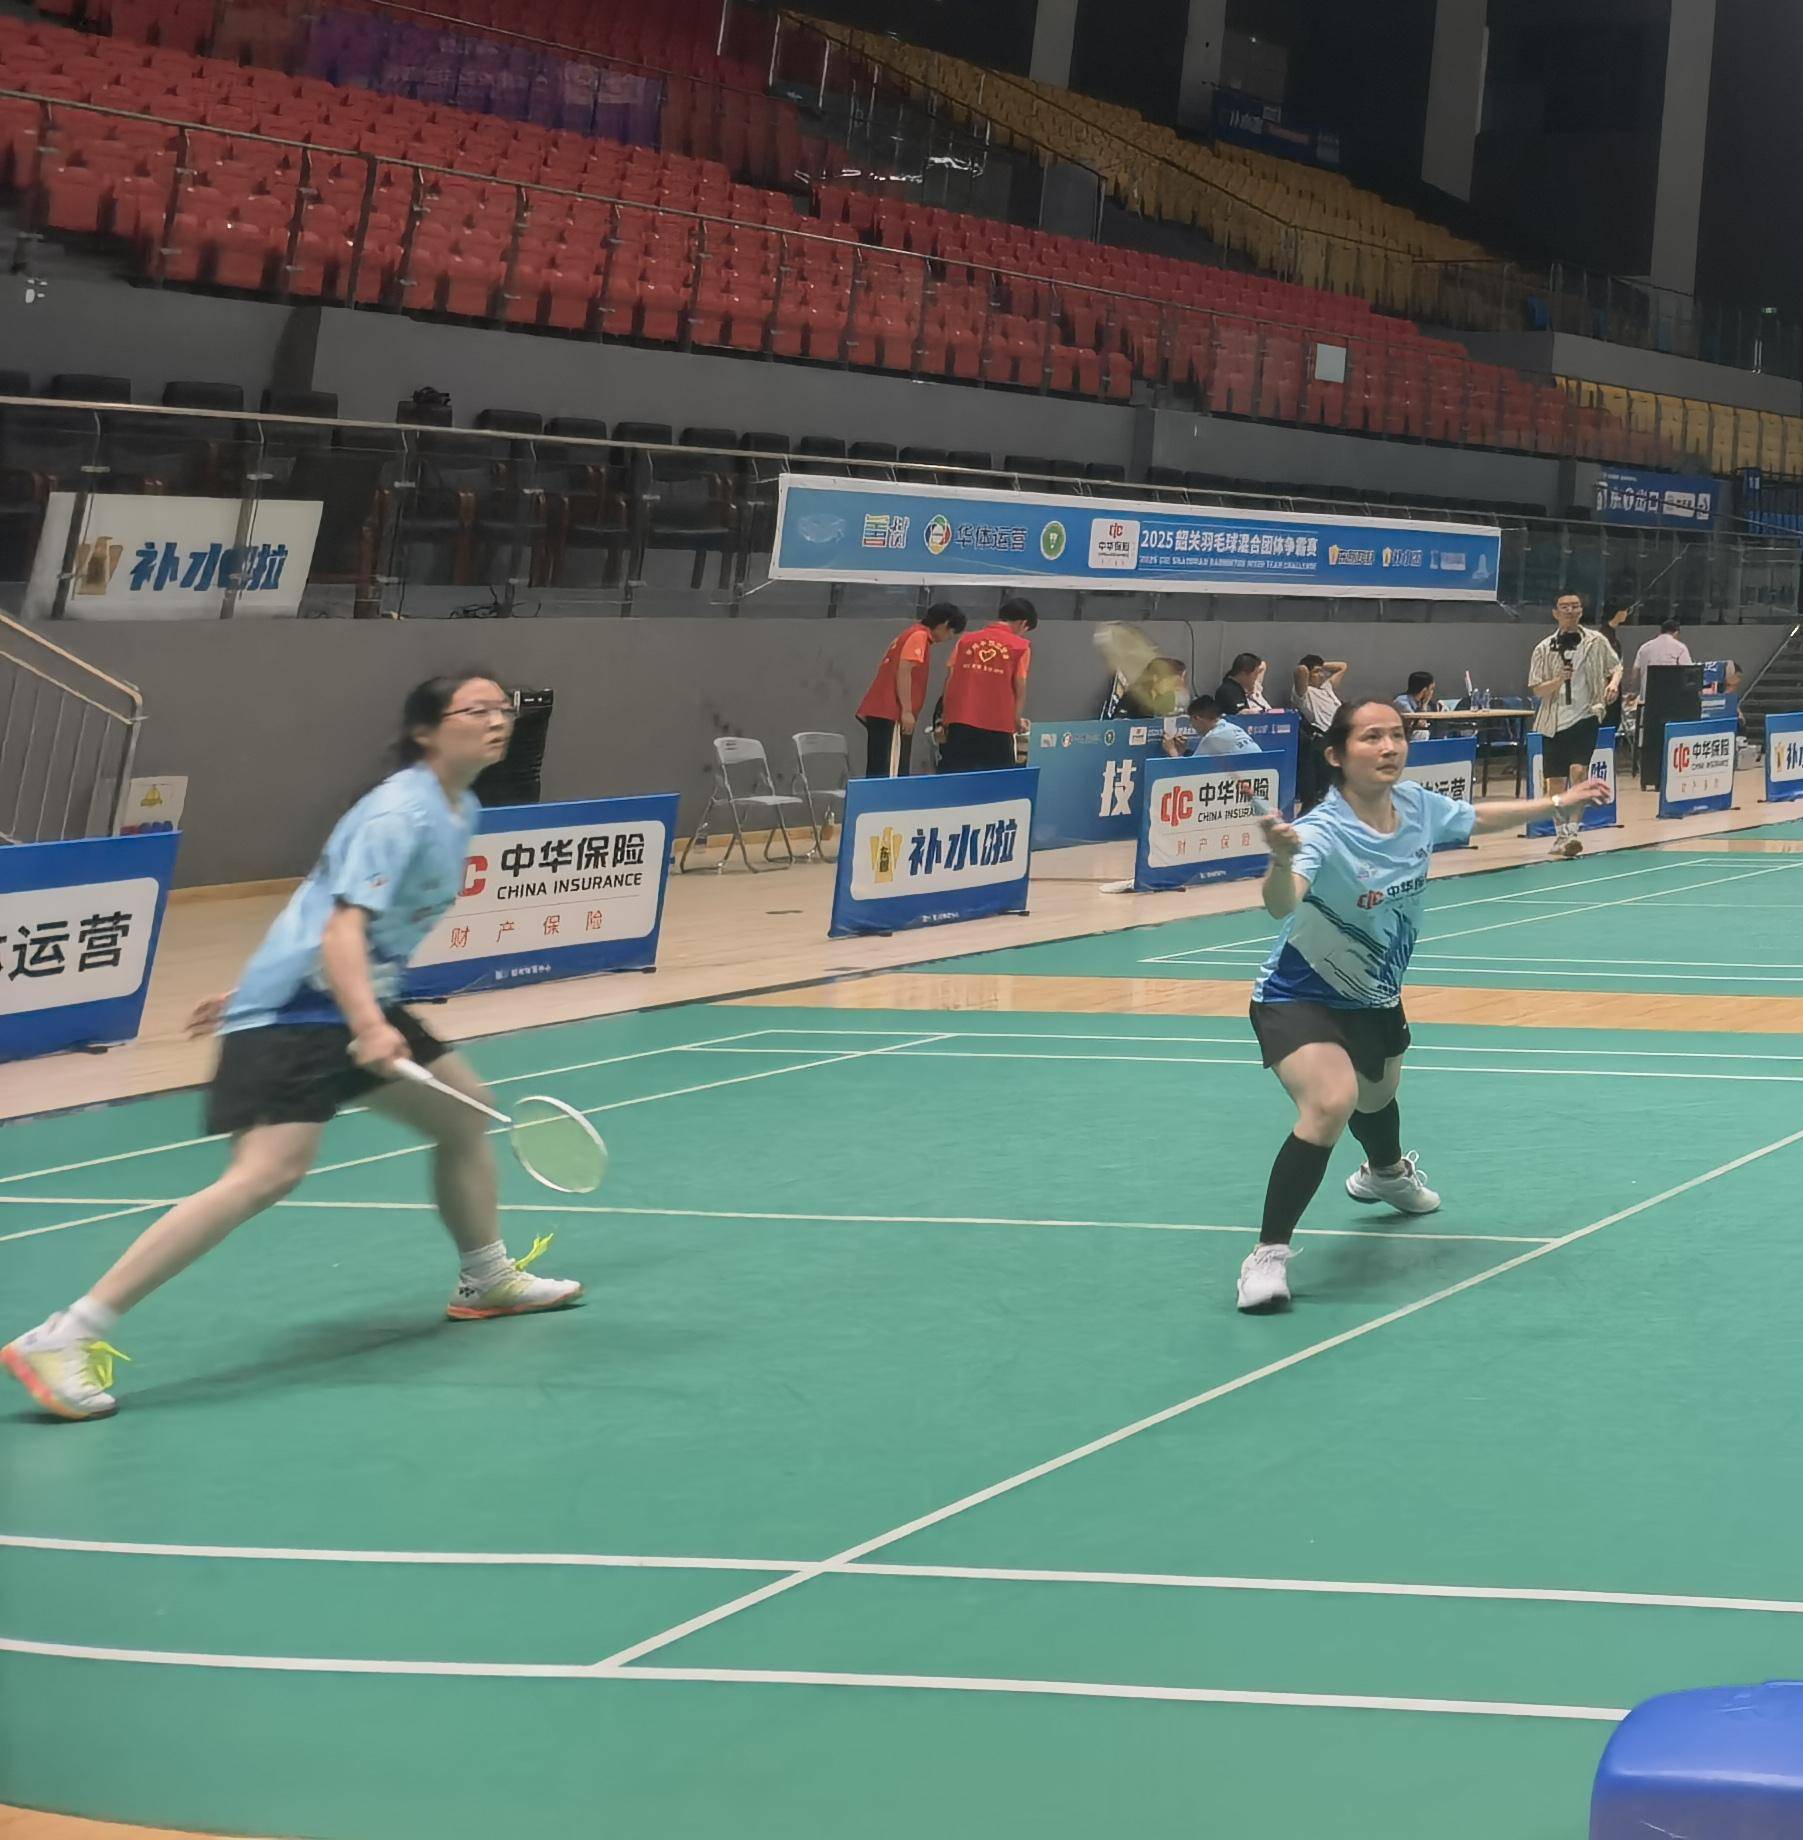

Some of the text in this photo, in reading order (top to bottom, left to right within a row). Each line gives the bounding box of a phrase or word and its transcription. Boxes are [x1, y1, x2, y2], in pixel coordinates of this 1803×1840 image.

[953, 524, 1028, 553] 华体运营
[129, 541, 289, 592] 补水啦
[1692, 738, 1730, 759] 中华保险
[1098, 759, 1137, 817] 技
[1200, 776, 1270, 807] 中华保险
[1198, 810, 1222, 824] CHINA
[500, 832, 645, 878] 中华保险
[908, 818, 1018, 876] 补水啦
[496, 872, 643, 901] CHINA INSURANCE
[0, 910, 133, 982] 运营
